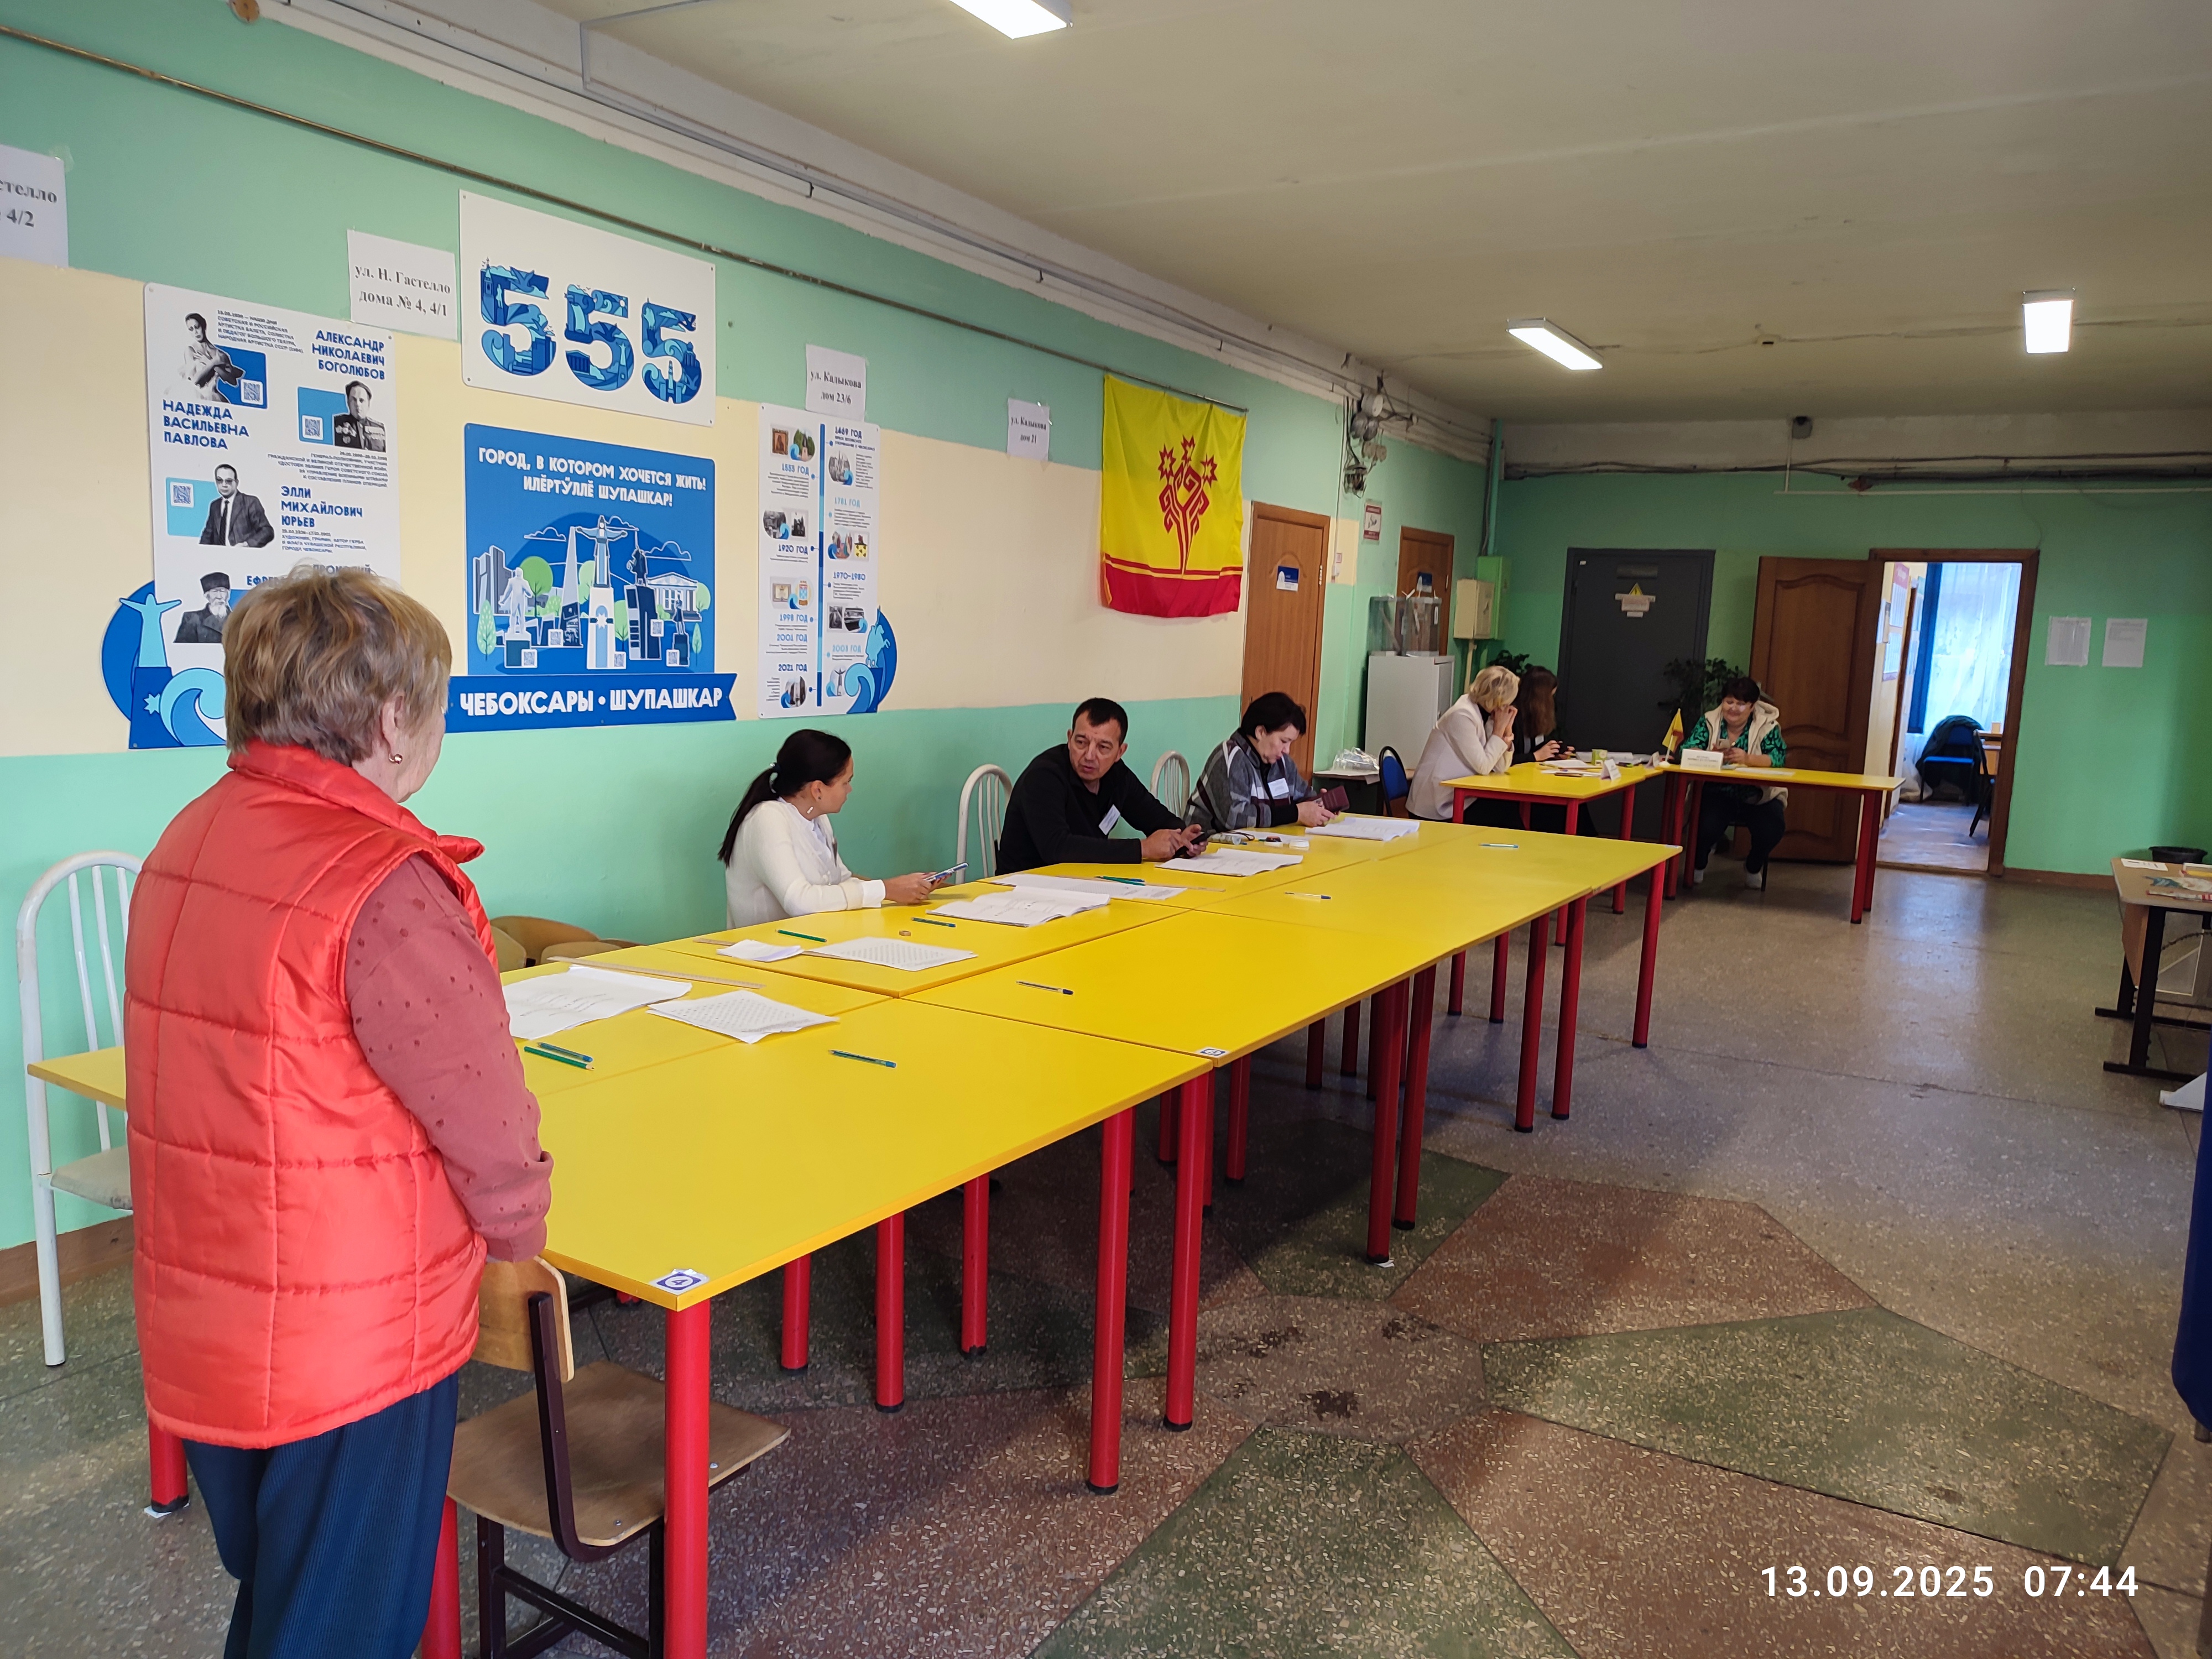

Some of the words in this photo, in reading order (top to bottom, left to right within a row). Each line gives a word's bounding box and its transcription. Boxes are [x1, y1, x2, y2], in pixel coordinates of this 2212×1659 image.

[6, 208, 34, 227] 4/2
[355, 266, 374, 278] ул.
[378, 268, 392, 282] Н.
[396, 271, 451, 294] Гастелло
[359, 291, 393, 306] дома
[397, 295, 411, 310] №
[415, 299, 426, 315] 4,
[430, 302, 447, 316] 4/1
[315, 330, 384, 353] АЛЕКСАНДР
[479, 264, 702, 404] 555
[312, 343, 385, 367] НИКОЛАЕВИЧ
[318, 359, 385, 380] БОГОЛЮБОВ
[811, 371, 821, 381] ул.
[821, 392, 834, 401] дом
[836, 392, 851, 405] 23/6
[163, 399, 233, 420] НАДЕЖДА
[163, 415, 249, 437] ВАСИЛЬЕВНА
[835, 426, 849, 436] 1469
[851, 429, 862, 439] ГОД
[164, 431, 228, 450] ПАВЛОВА
[479, 447, 531, 471] ГОРОД,
[536, 455, 544, 469] В
[549, 457, 614, 479] КОТОРОМ
[619, 466, 672, 486] ХОЧЕТСЯ
[675, 473, 706, 491] ЖИТЬ!
[797, 466, 809, 476] ГОД
[281, 486, 311, 498] ЭЛЛИ
[599, 484, 672, 507] ШУПАШКАР!
[281, 500, 363, 517] МИХАЙЛОВИЧ
[849, 499, 860, 508] ГОД
[281, 515, 315, 527] ЮРЬЕВ
[778, 544, 794, 552] 1920
[796, 546, 808, 555] ГОД
[796, 614, 808, 623] ГОД
[796, 634, 807, 643] ГОД
[851, 645, 861, 653] ГОД
[796, 664, 808, 672] ГОД
[460, 690, 594, 716] ЧЕБОКСАРЫ
[609, 687, 722, 711] ШУПАШКАР
